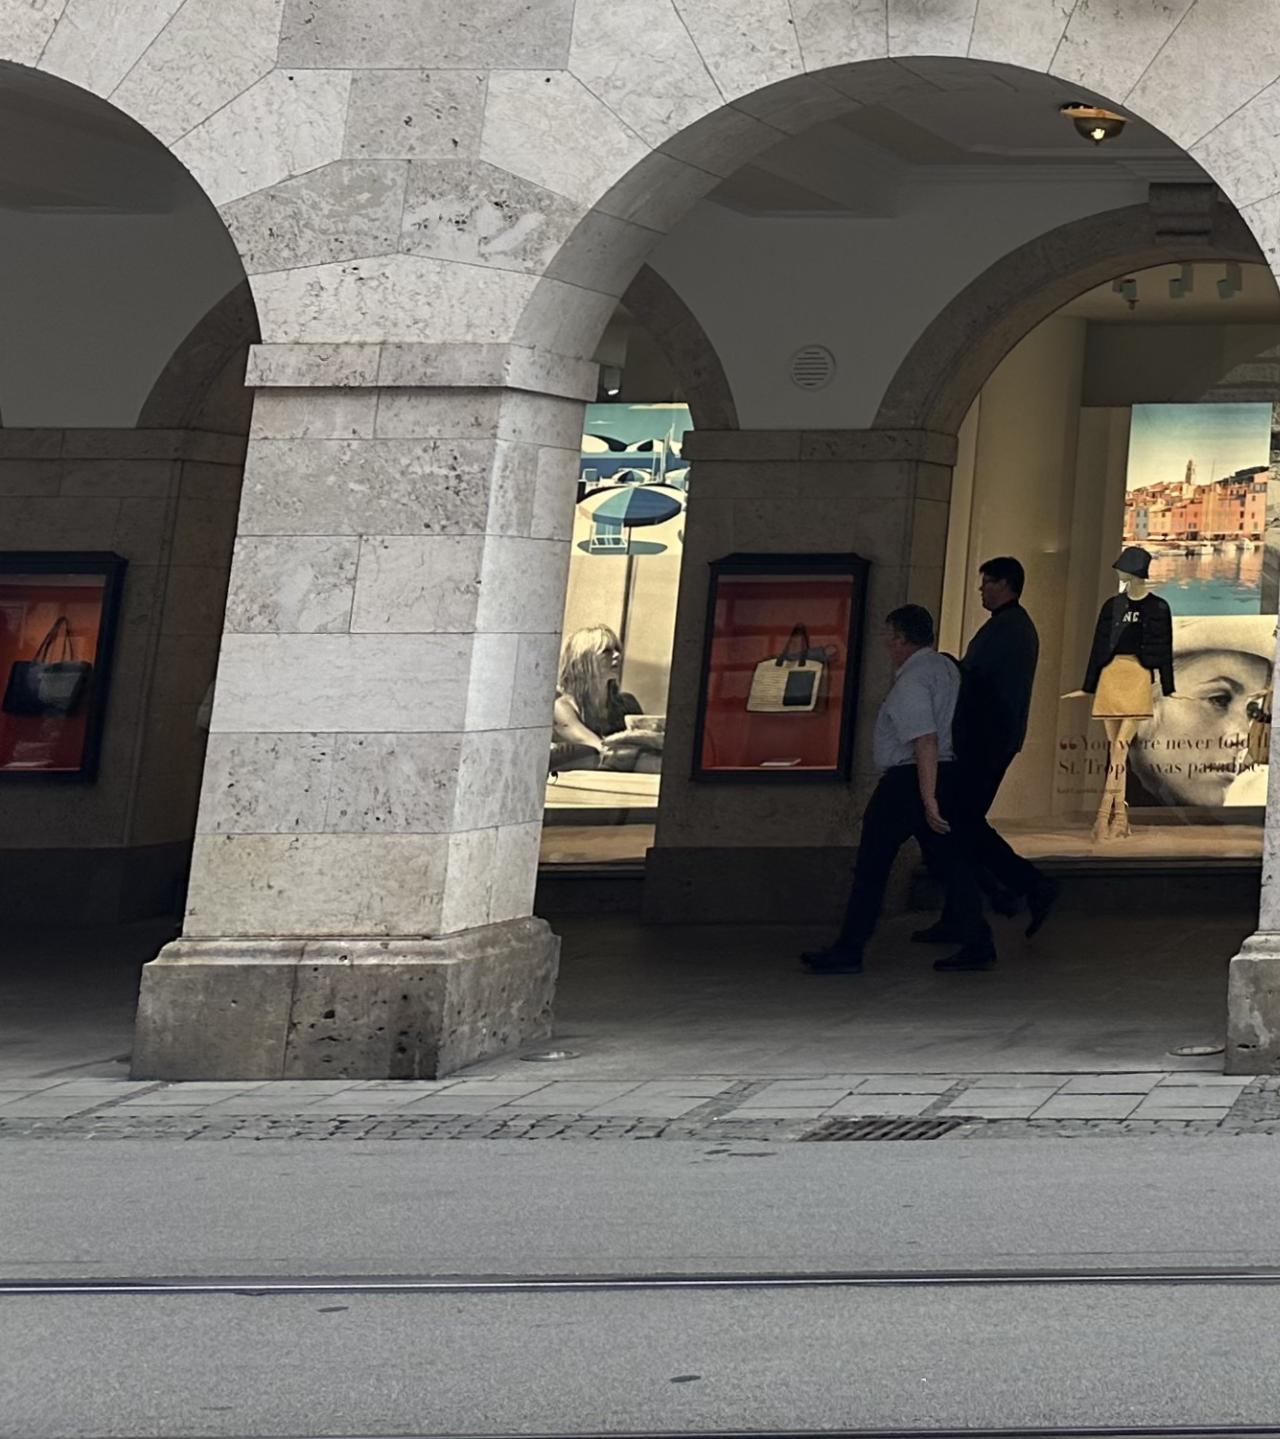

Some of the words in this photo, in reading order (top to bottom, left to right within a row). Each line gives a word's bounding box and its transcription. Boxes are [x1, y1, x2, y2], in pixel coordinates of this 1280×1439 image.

[1166, 738, 1212, 751] never
[1219, 732, 1250, 748] told
[1147, 762, 1181, 775] was
